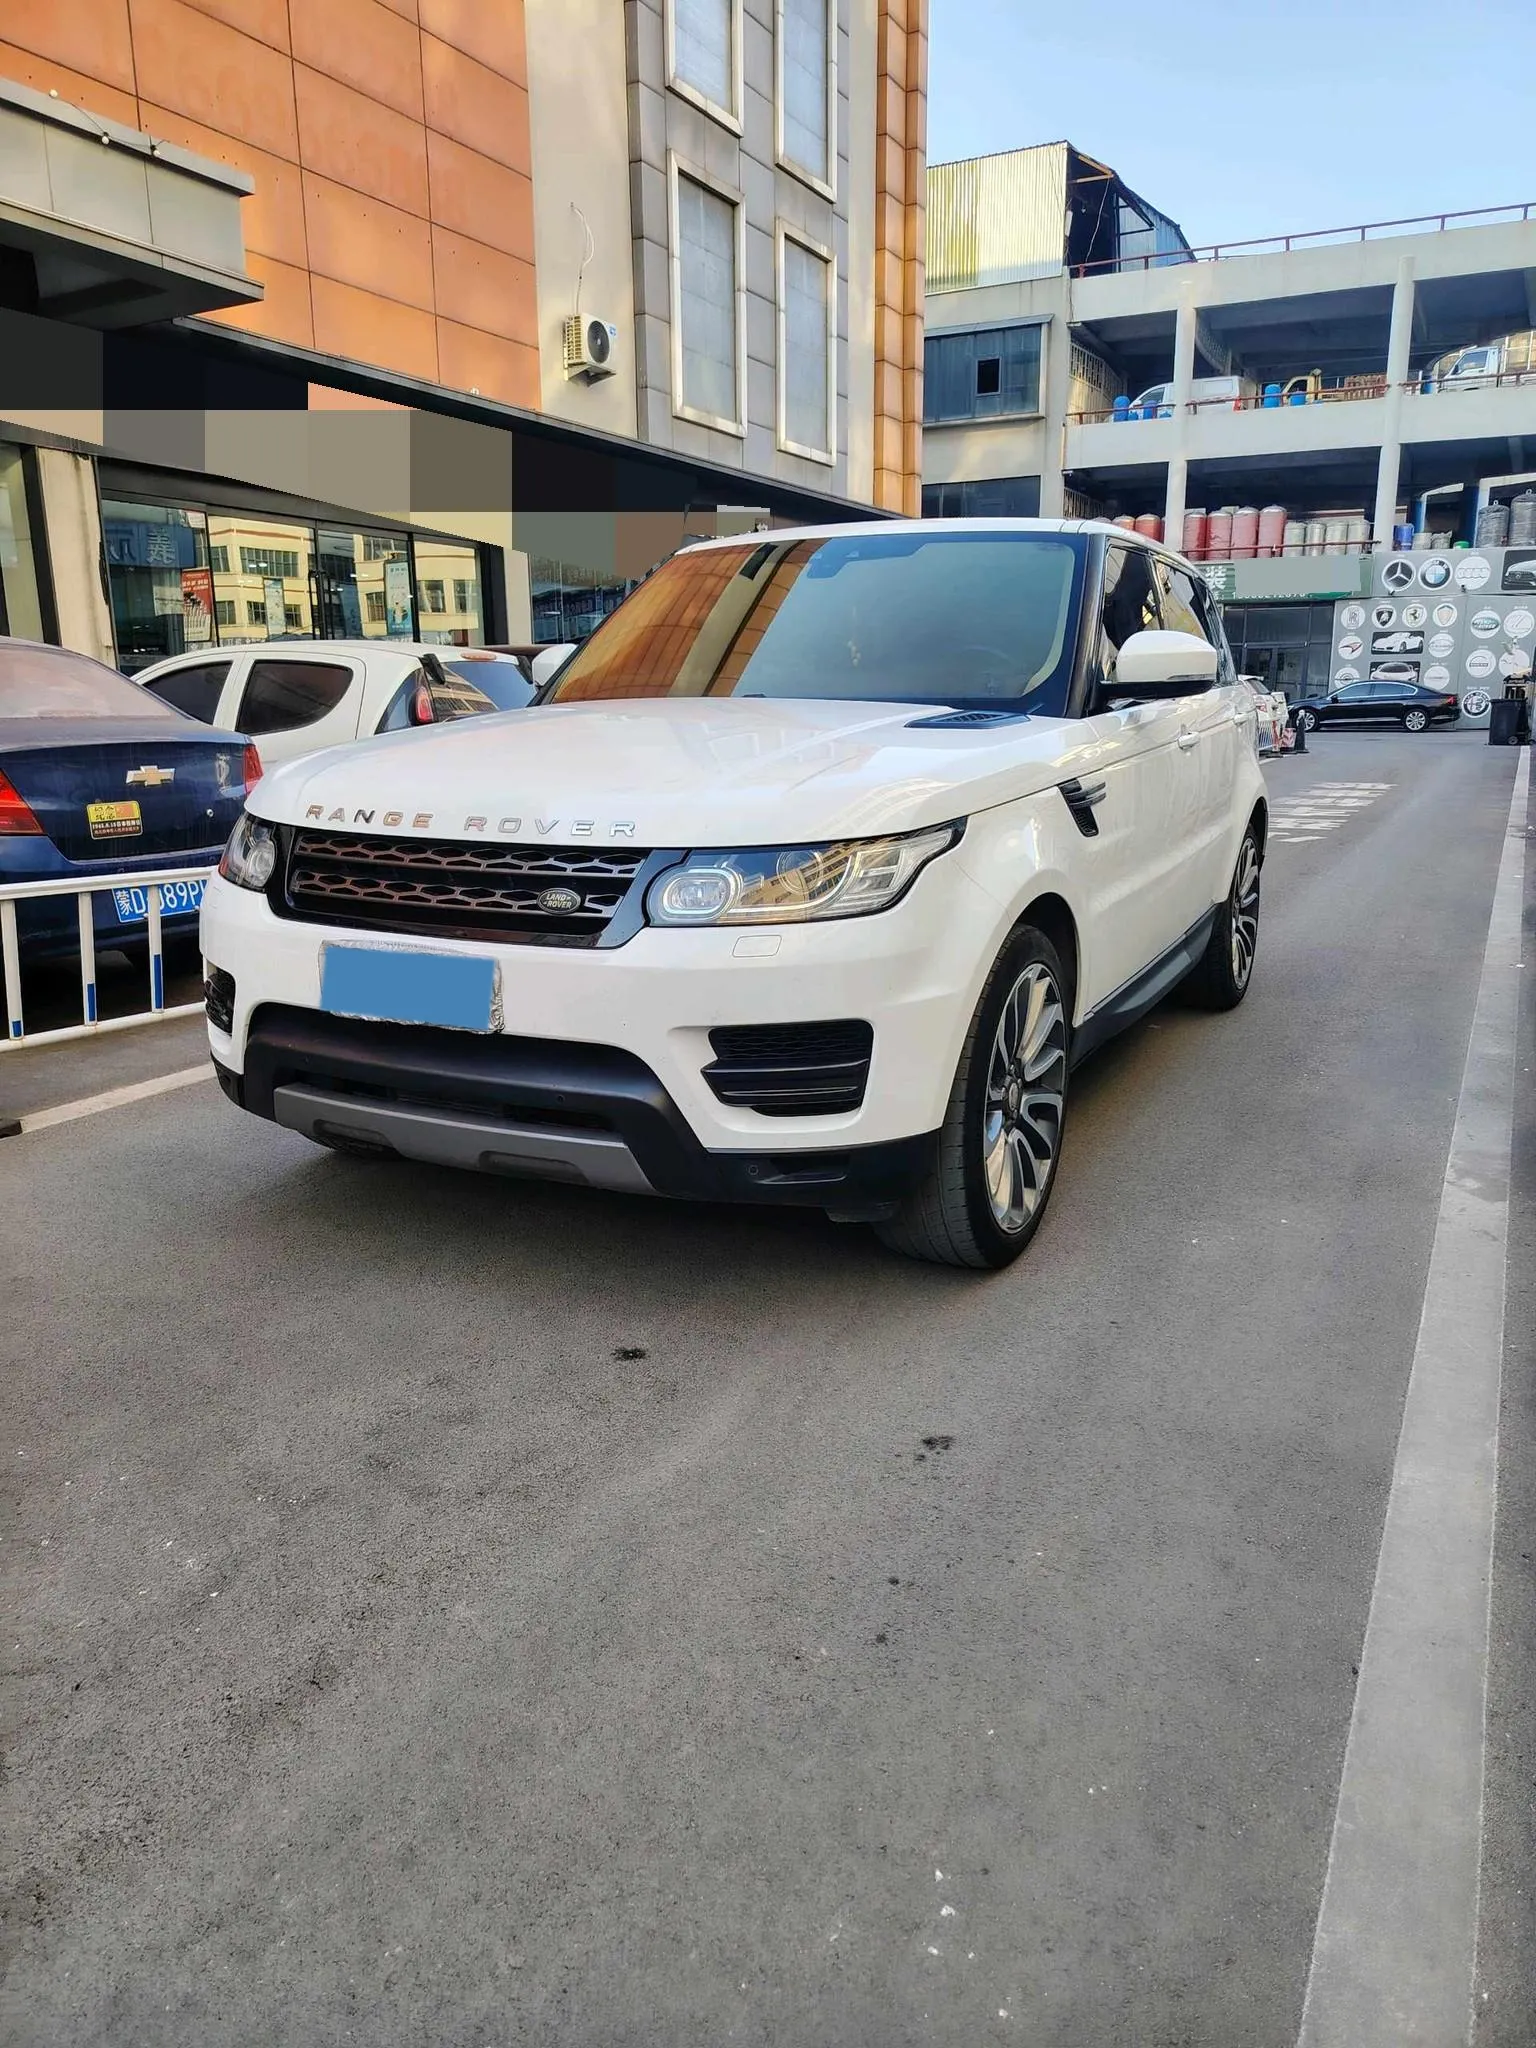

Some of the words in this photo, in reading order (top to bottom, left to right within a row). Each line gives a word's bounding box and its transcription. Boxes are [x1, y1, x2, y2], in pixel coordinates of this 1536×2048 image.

[306, 804, 433, 828] RANGE
[464, 815, 636, 837] ROVER
[546, 893, 567, 902] LAND
[547, 900, 572, 909] ROVER
